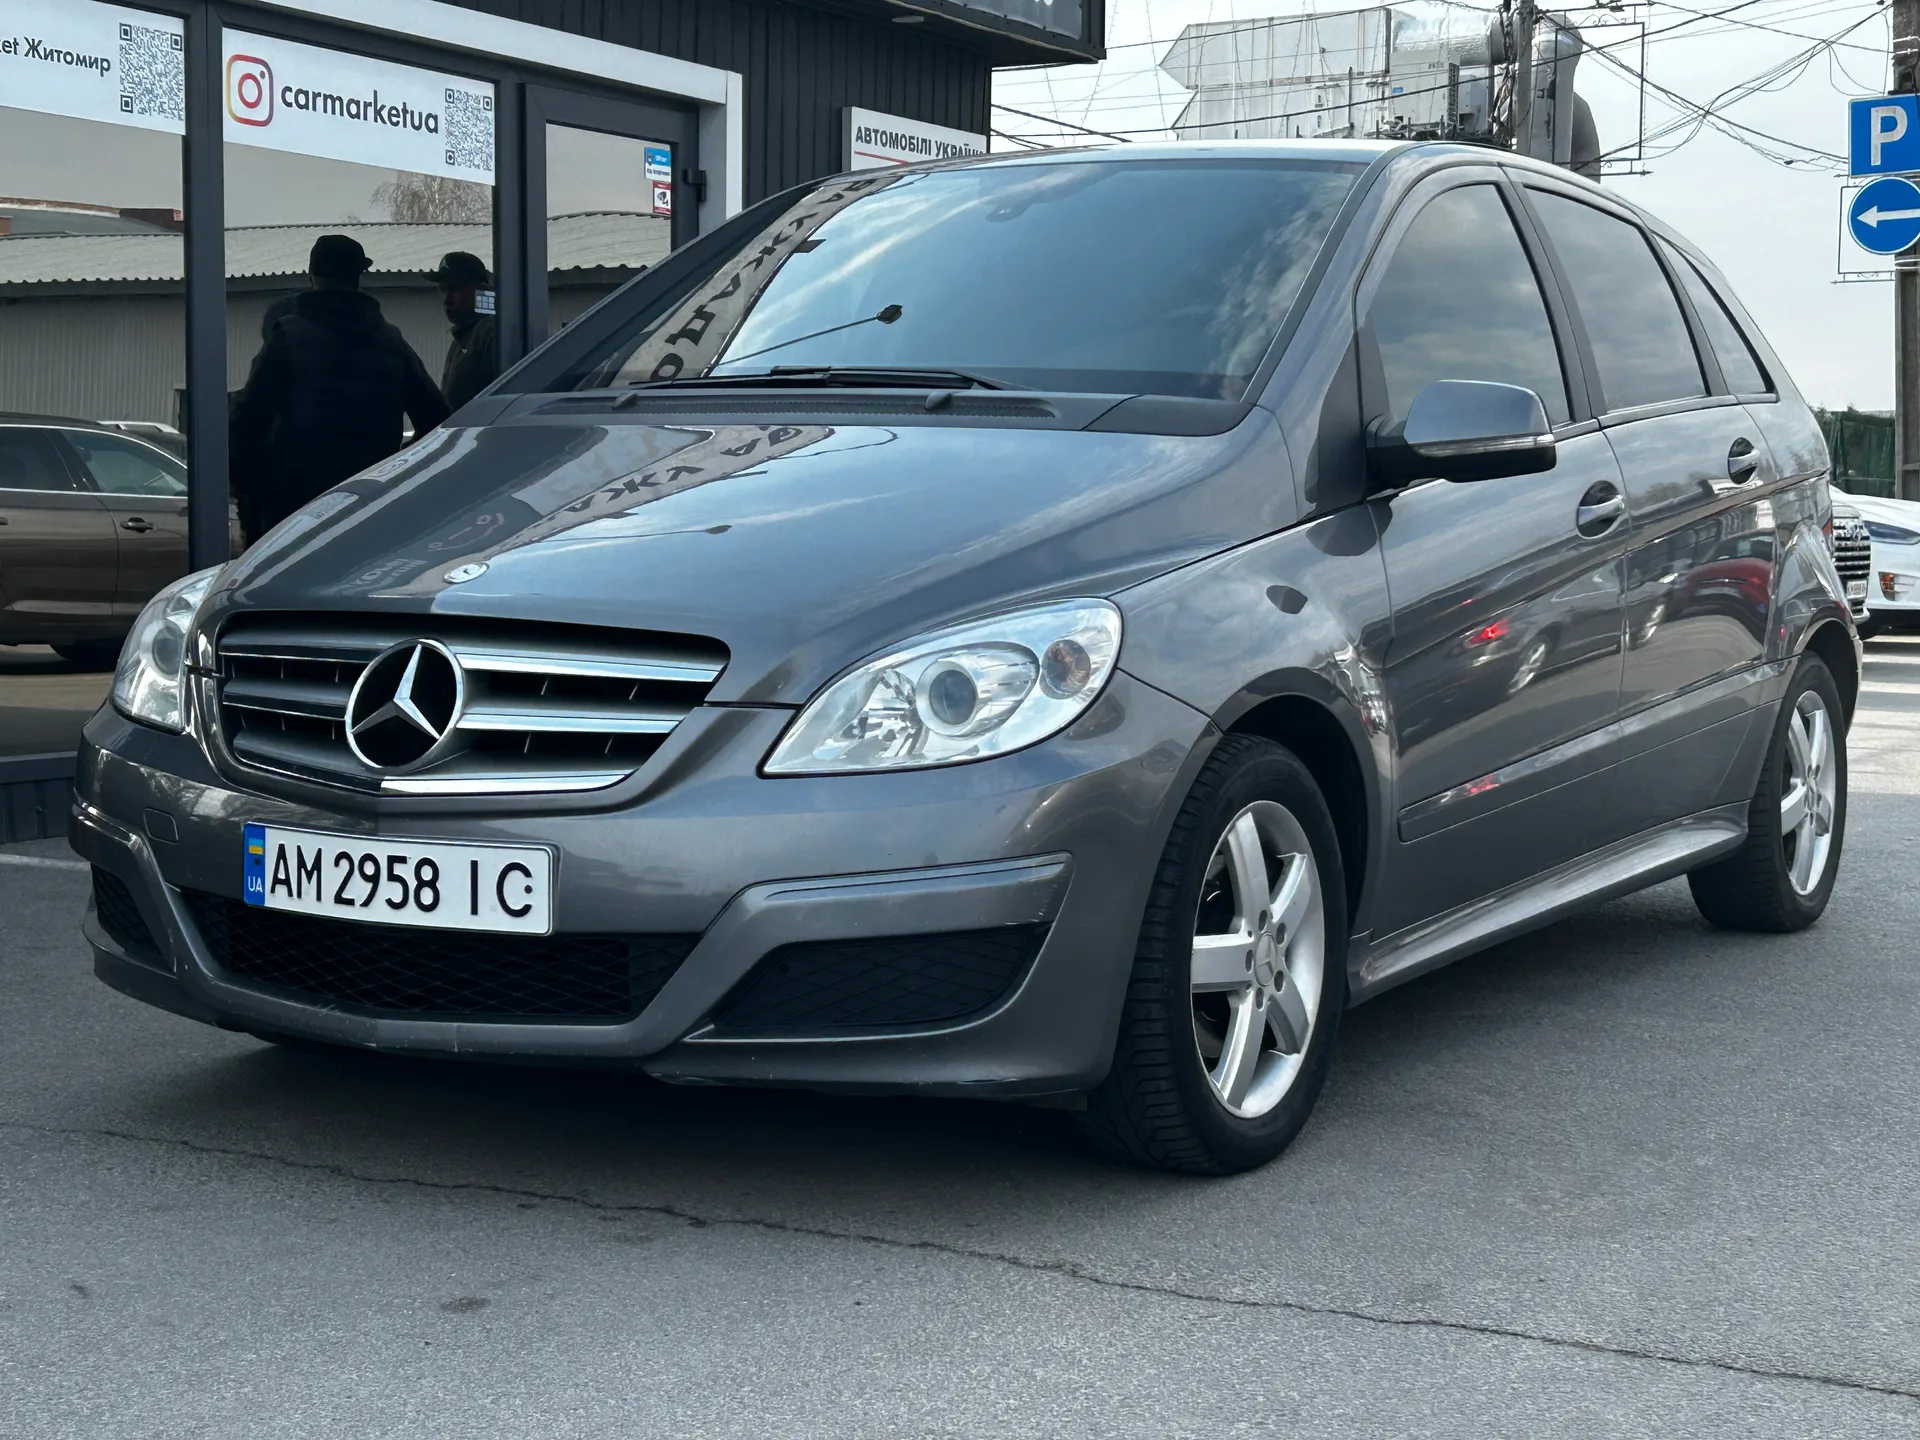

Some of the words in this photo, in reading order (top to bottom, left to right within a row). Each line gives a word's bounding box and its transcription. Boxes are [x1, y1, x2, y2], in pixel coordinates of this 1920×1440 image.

[0, 37, 19, 56] et
[23, 36, 111, 77] Житомир
[281, 83, 439, 134] carmarketua
[855, 126, 932, 157] АВТОМОБІЛІ
[1870, 105, 1908, 166] P
[247, 874, 264, 894] UA
[333, 851, 441, 913] 2958
